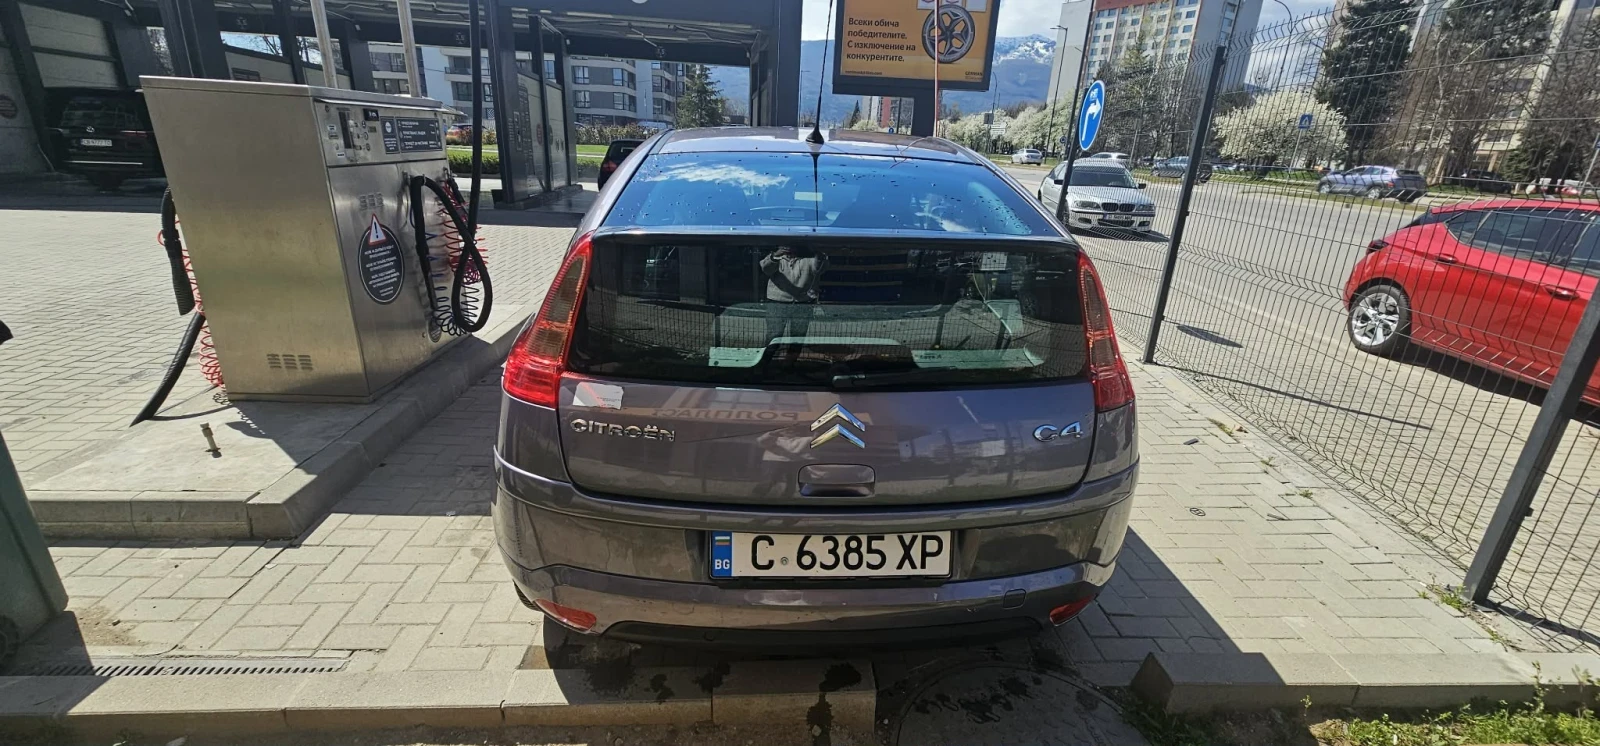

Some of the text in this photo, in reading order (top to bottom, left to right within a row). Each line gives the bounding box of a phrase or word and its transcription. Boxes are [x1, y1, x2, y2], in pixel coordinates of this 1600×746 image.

[848, 17, 900, 28] Всеки обича
[847, 29, 908, 40] победителите.
[847, 40, 853, 49] С
[854, 42, 905, 51] изключение
[846, 53, 905, 62] конкурентите.
[570, 418, 676, 442] CITROËN
[1032, 421, 1084, 442] C4
[751, 534, 944, 570] C 6385 XP
[714, 559, 730, 570] BG
